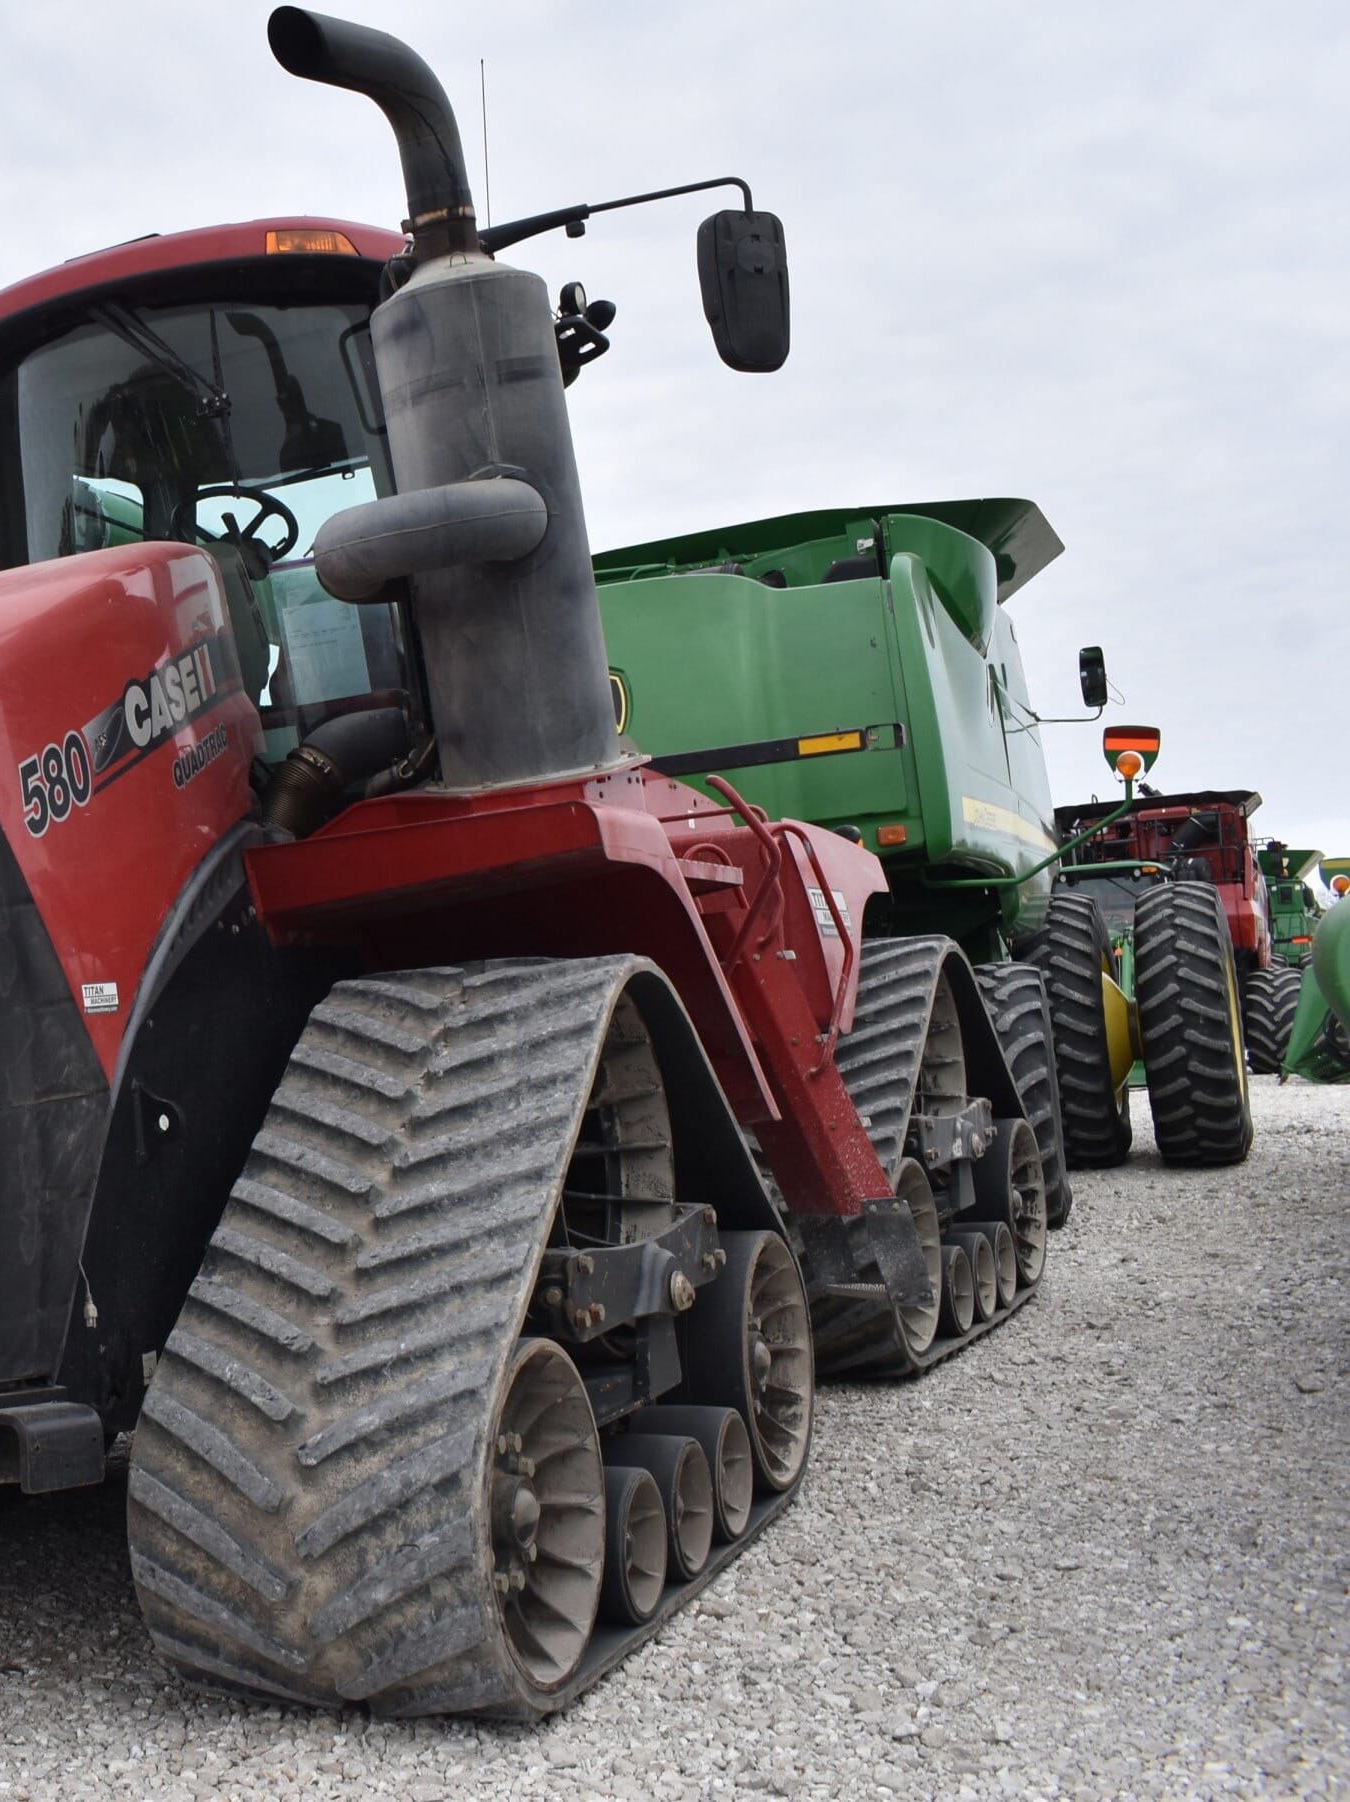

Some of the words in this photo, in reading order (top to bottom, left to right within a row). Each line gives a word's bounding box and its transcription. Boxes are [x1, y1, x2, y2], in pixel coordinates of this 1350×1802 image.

[124, 655, 201, 747] CASE
[18, 730, 92, 839] 580
[171, 722, 229, 790] QUADTRAC
[84, 985, 105, 996] TITAN
